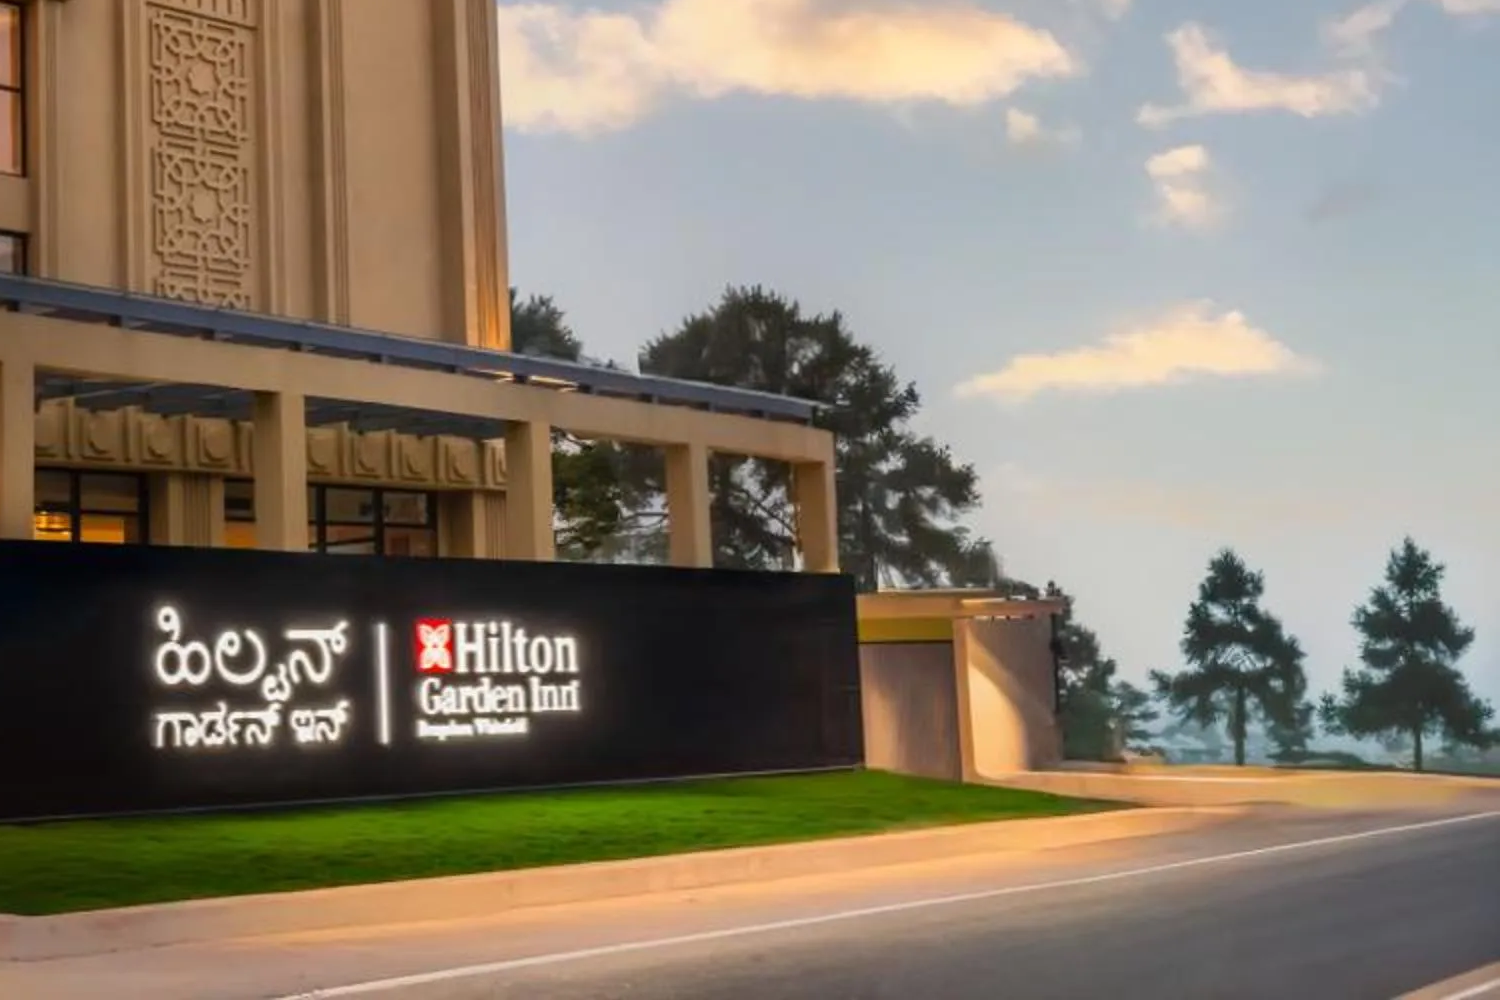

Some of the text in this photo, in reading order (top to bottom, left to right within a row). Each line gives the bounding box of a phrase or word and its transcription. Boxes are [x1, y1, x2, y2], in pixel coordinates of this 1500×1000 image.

[454, 621, 579, 673] Hilton
[420, 676, 580, 714] Garden Inn
[290, 699, 349, 743] ಇನ್
